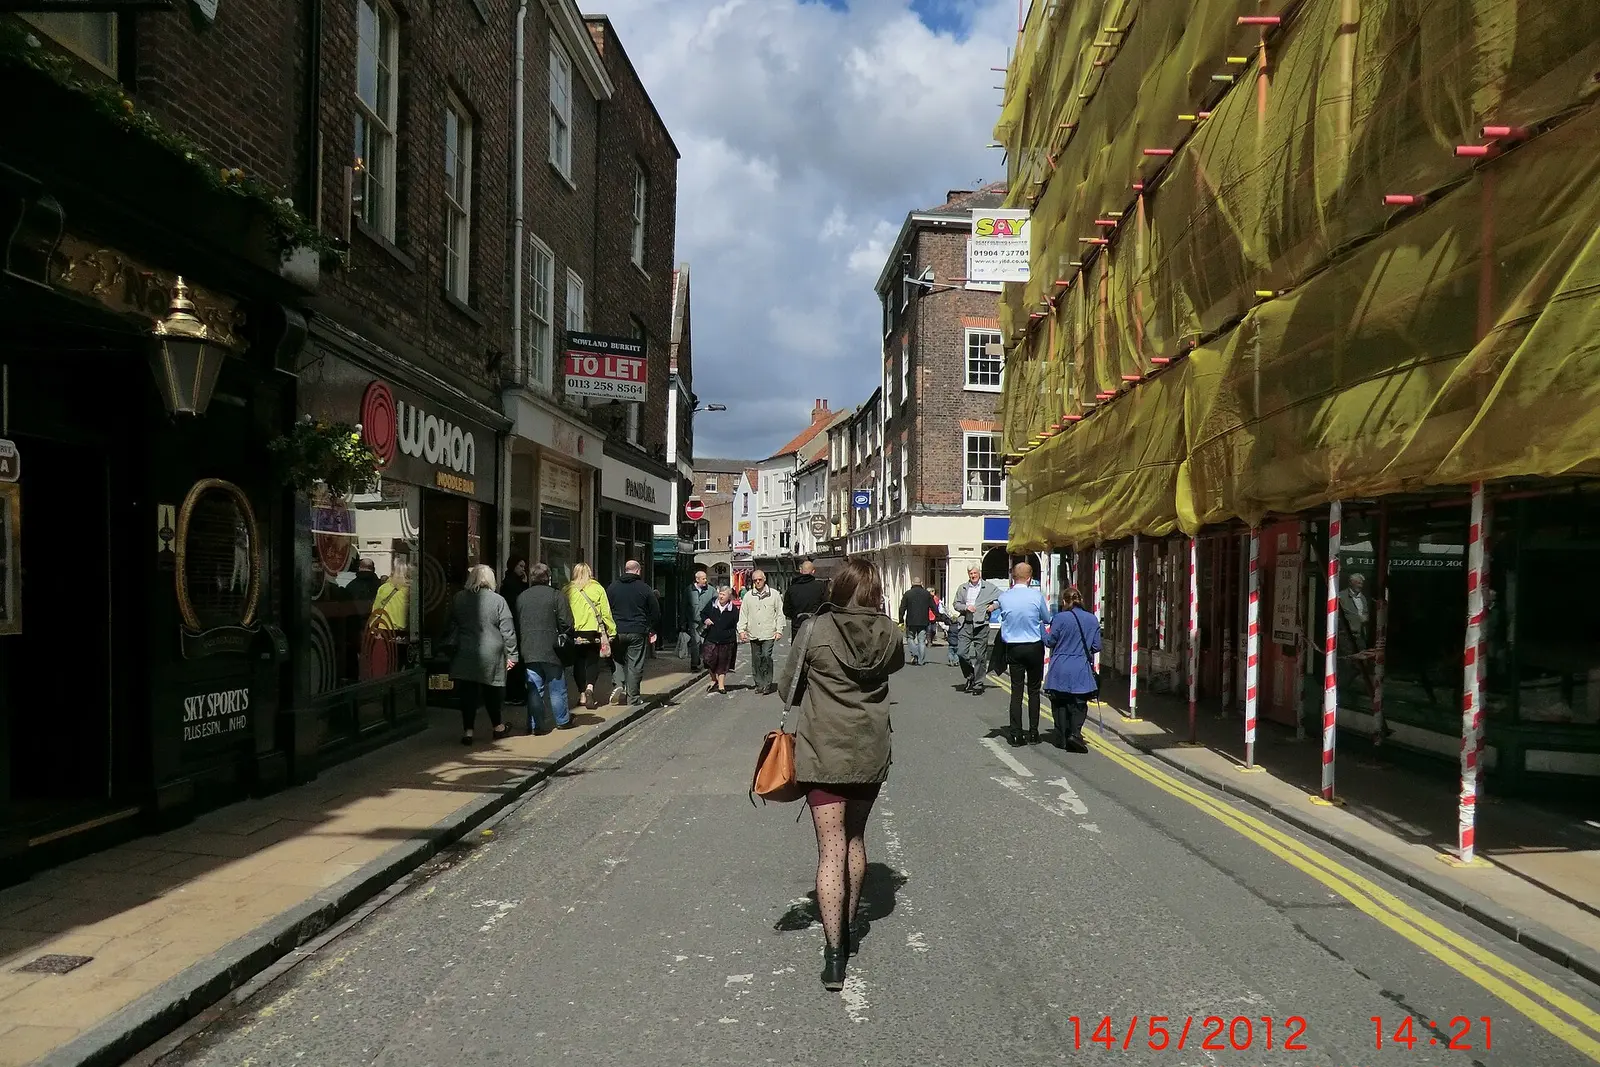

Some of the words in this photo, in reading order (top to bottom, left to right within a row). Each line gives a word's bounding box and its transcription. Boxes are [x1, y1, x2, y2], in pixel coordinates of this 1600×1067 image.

[976, 217, 1026, 236] SAY
[572, 337, 608, 348] ROWLAND
[610, 342, 641, 352] BURKITT
[571, 354, 599, 375] TO
[604, 357, 643, 380] LET
[568, 379, 590, 389] 0113
[593, 381, 614, 392] 258
[616, 383, 643, 394] 8564
[437, 471, 463, 491] NOODLE
[625, 477, 656, 504] PANDORA
[183, 694, 206, 722] SKY
[207, 688, 249, 718] SPORTS
[184, 724, 202, 742] PLUS
